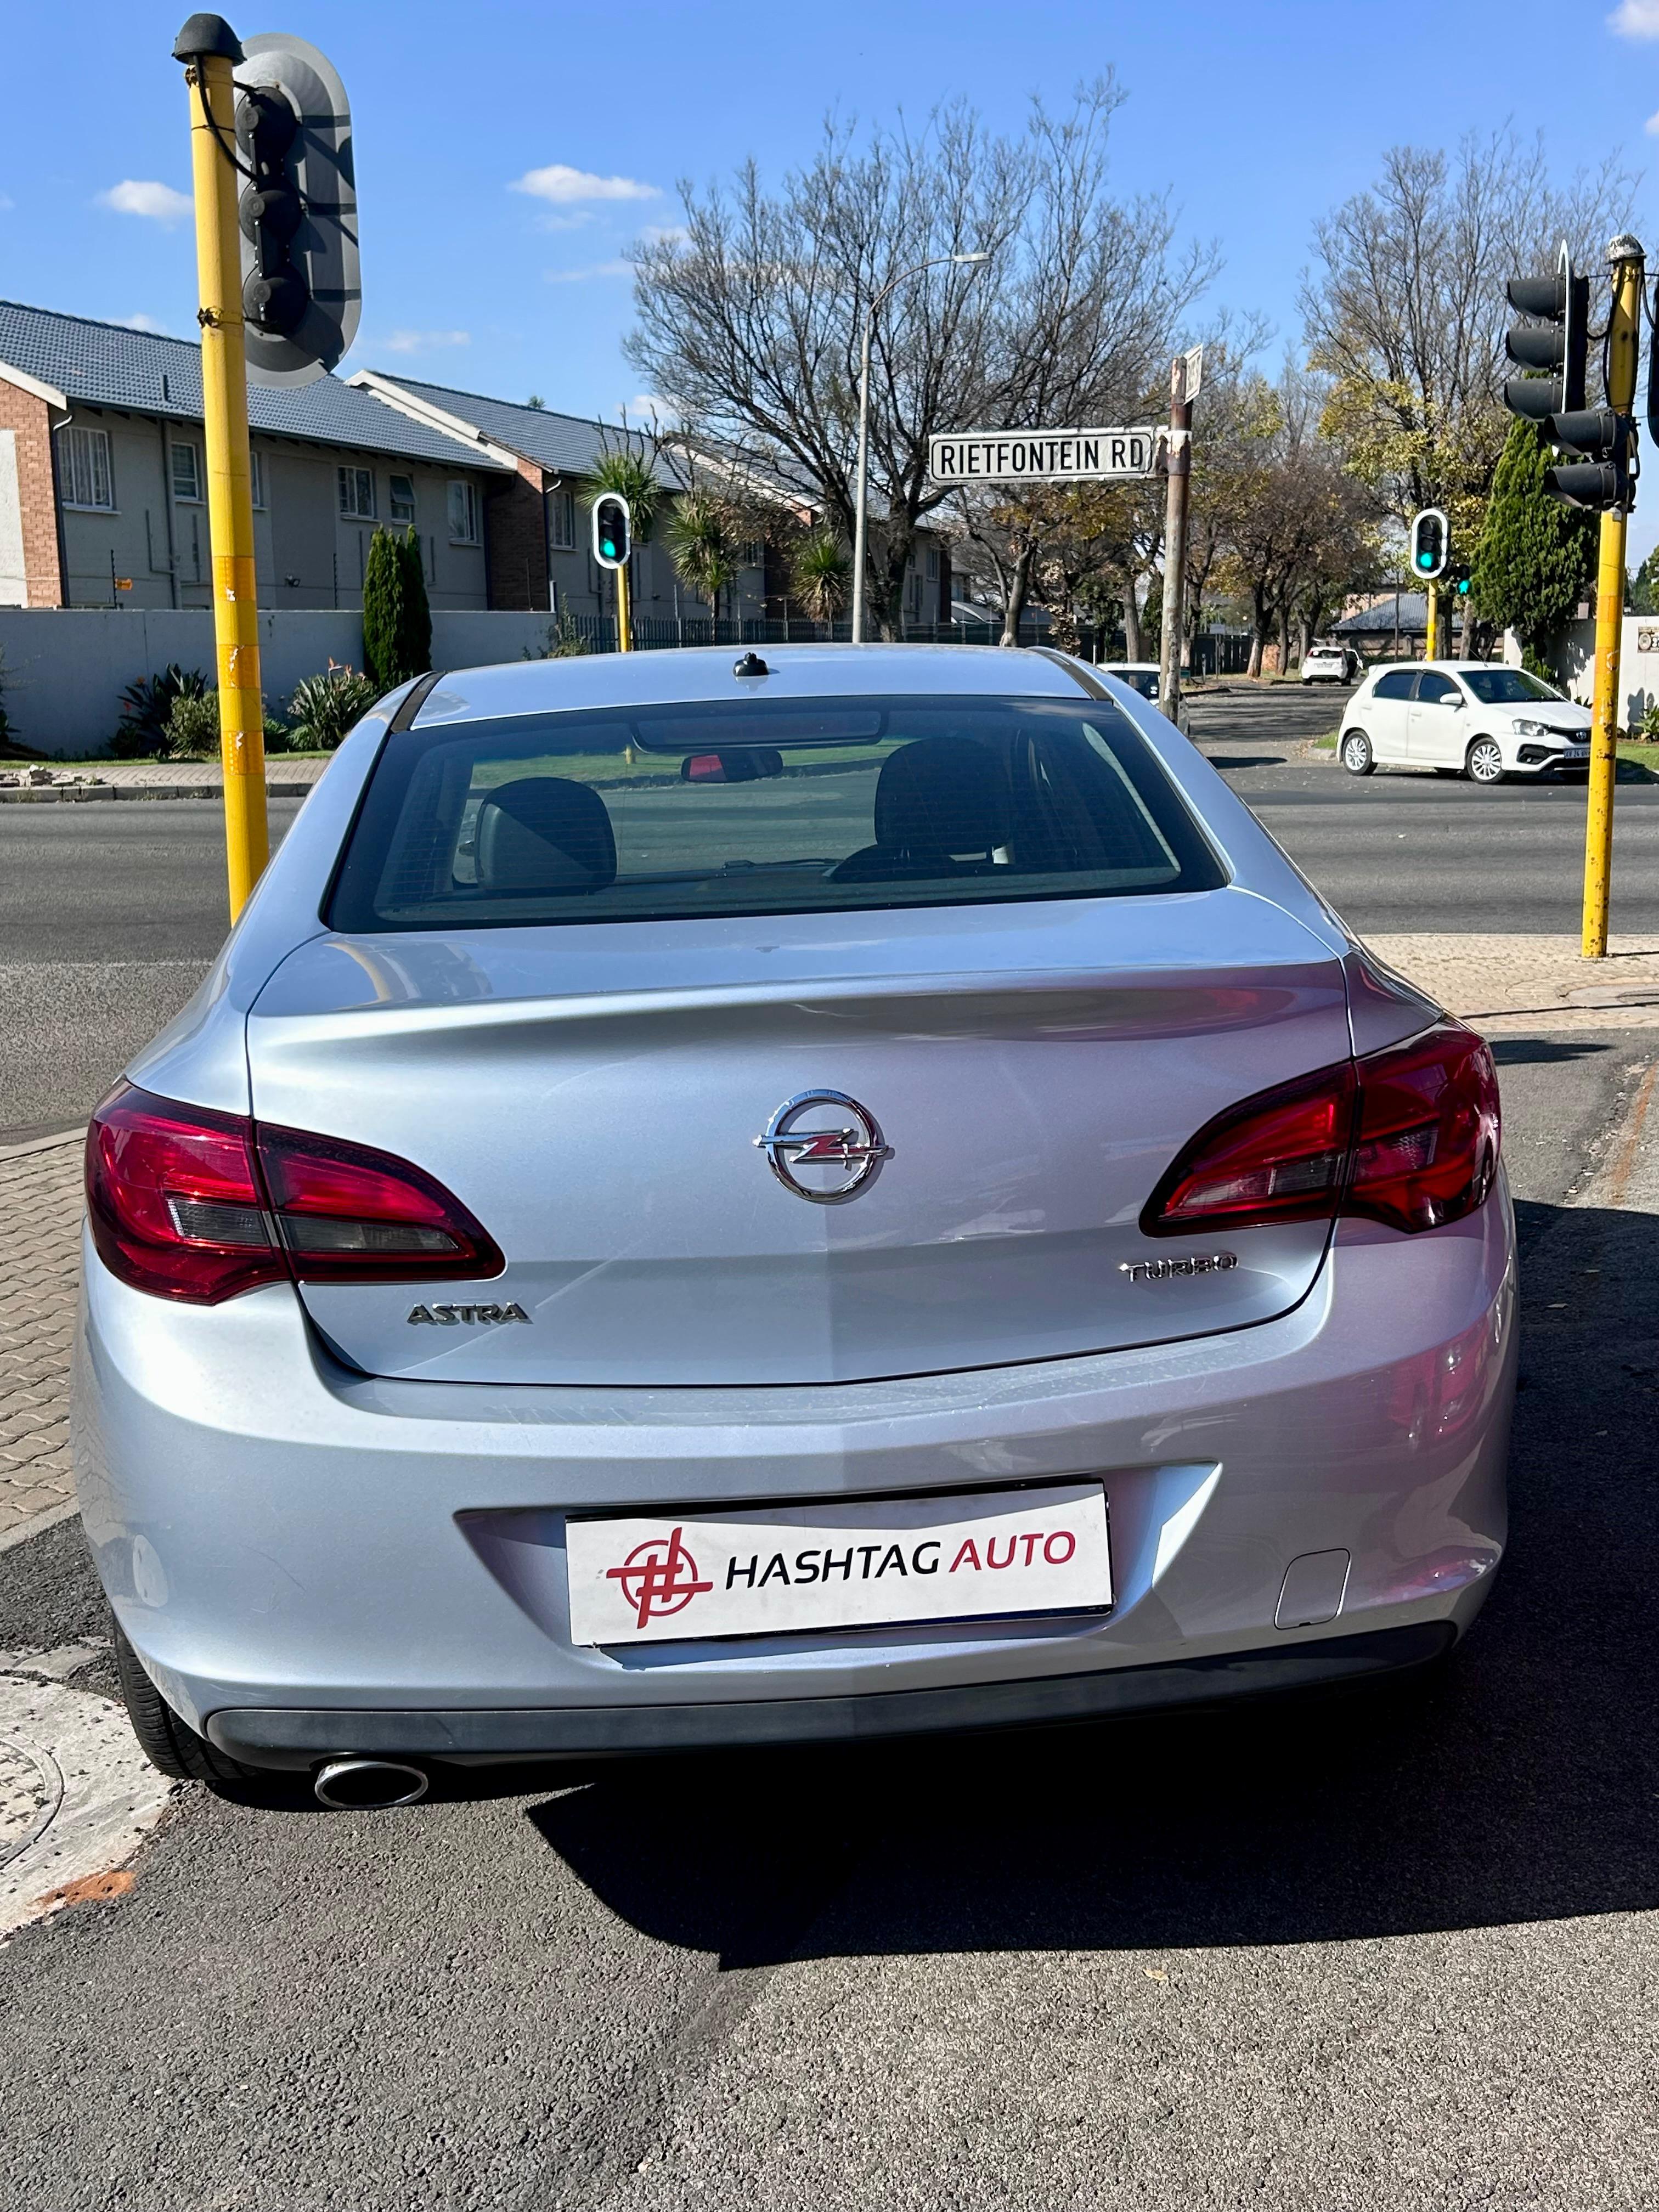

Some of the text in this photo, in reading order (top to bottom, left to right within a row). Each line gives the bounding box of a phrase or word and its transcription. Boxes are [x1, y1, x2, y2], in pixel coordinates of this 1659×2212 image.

[941, 438, 1143, 474] RIETFONTEIN RD
[1119, 1254, 1238, 1282] TURBO
[407, 1303, 532, 1322] ASTRA
[726, 1531, 1076, 1589] HASHTAG AUTO
